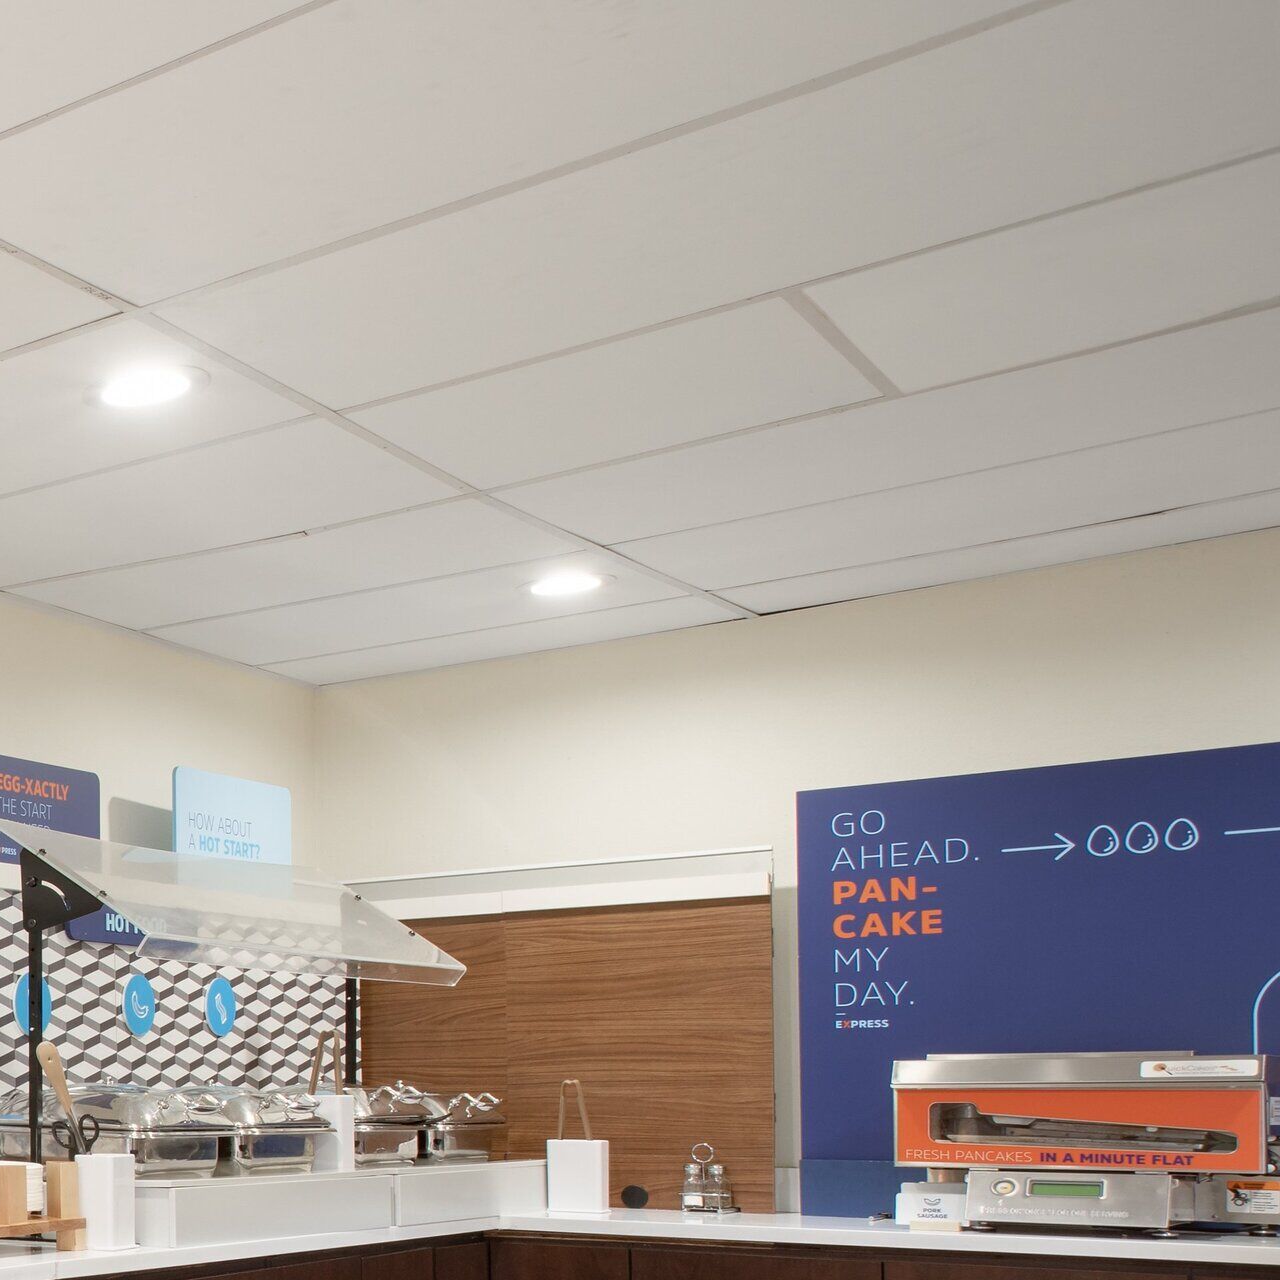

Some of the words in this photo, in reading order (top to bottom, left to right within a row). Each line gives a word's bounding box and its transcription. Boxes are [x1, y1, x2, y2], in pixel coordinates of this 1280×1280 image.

[20, 800, 52, 820] START
[831, 810, 886, 837] GO
[188, 811, 215, 832] HOW
[218, 818, 252, 840] ABOUT
[189, 833, 195, 849] A
[199, 835, 220, 853] HOT
[224, 839, 260, 860] START?
[831, 838, 979, 872] AHEAD.
[832, 876, 938, 905] PAN-
[832, 909, 943, 939] CAKE
[834, 947, 889, 973] MY
[835, 981, 915, 1007] DAY.
[835, 1019, 889, 1029] EXPRESS
[905, 1149, 950, 1160] FRESH
[955, 1150, 1033, 1162] PANCAKES
[1040, 1152, 1057, 1162] IN
[1062, 1153, 1074, 1162] A
[1079, 1153, 1146, 1165] MINUTE
[1152, 1154, 1194, 1166] FLAT
